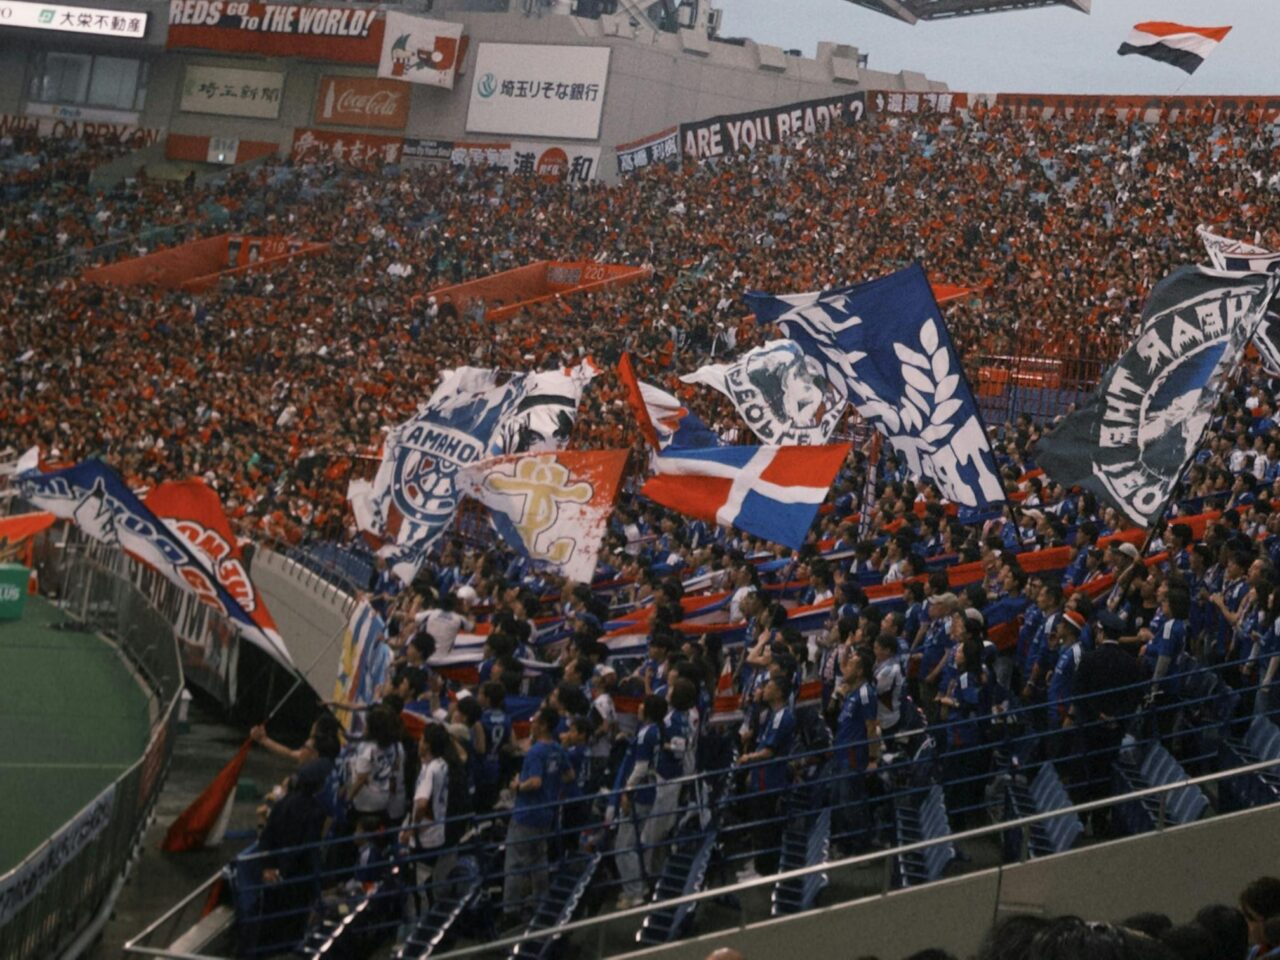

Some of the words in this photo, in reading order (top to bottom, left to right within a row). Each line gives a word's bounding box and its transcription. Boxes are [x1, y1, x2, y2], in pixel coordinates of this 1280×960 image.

[59, 11, 142, 33] 大栄不動産
[227, 2, 249, 17] GO
[240, 16, 258, 30] TO
[261, 5, 298, 33] THE
[297, 7, 377, 38] WORLD!
[500, 79, 599, 102] 埼玉りそな銀行
[684, 123, 724, 158] ARE
[727, 116, 773, 149] YOU
[569, 155, 593, 182] 和
[264, 240, 285, 253] 219
[584, 266, 605, 280] 220
